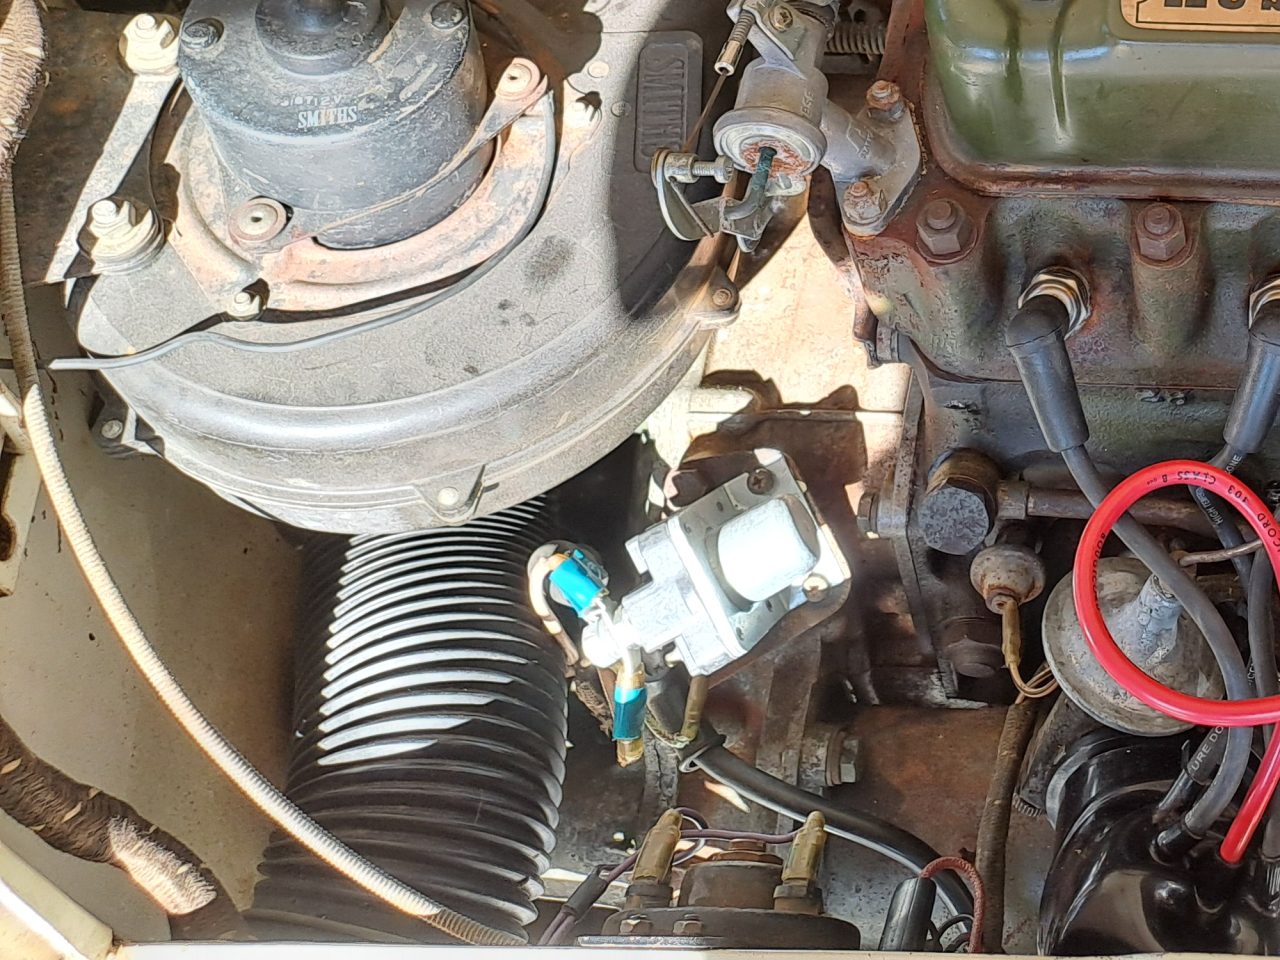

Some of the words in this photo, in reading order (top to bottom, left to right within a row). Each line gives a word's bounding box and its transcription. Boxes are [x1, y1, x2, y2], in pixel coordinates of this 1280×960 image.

[297, 106, 357, 128] SMITHS
[1161, 473, 1168, 484] B
[1177, 470, 1217, 486] CLASS
[1226, 485, 1250, 506] 103
